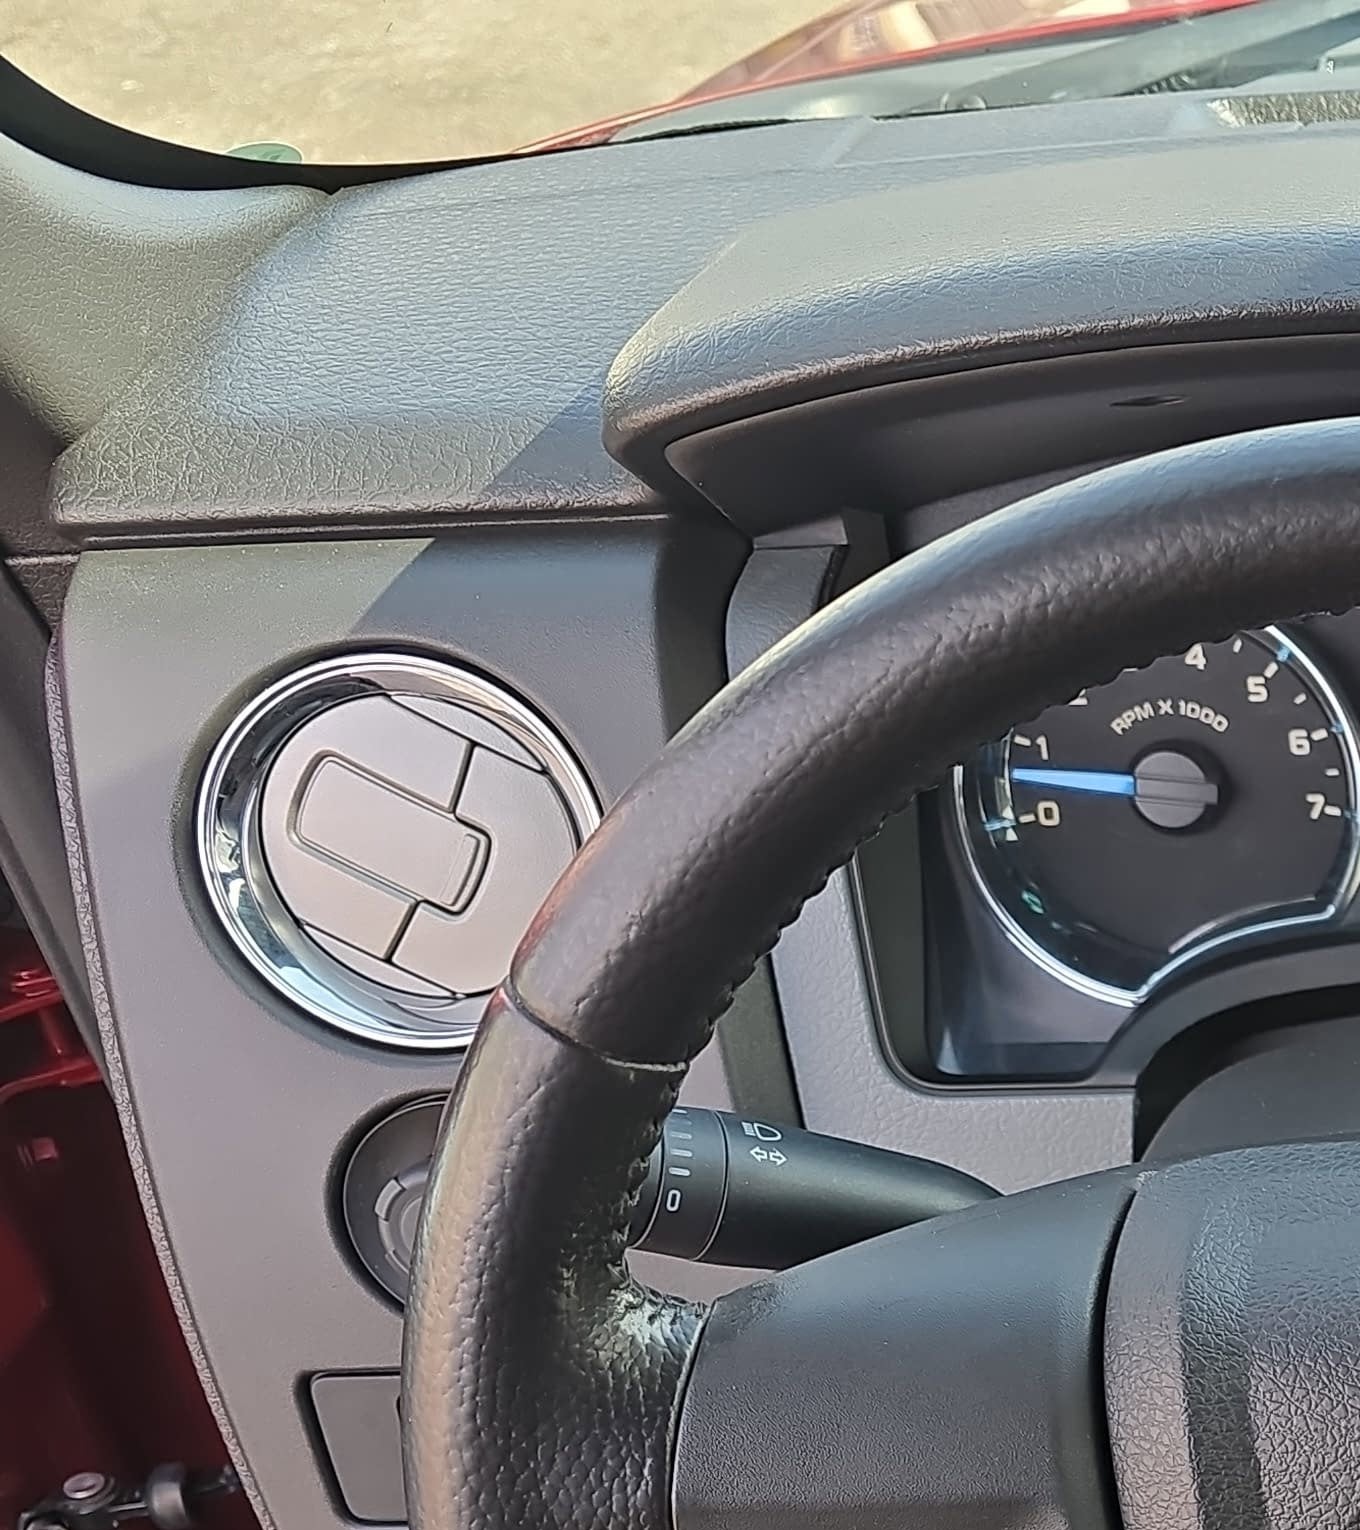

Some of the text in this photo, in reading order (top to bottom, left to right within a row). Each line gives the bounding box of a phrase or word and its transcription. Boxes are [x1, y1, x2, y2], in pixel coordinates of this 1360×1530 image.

[1184, 644, 1206, 670] 4
[1247, 676, 1268, 702] 5
[1110, 698, 1229, 735] RPM X 1000
[1034, 736, 1049, 760] 1
[1288, 729, 1310, 755] 6
[1036, 801, 1061, 827] 0
[1306, 796, 1324, 820] 7
